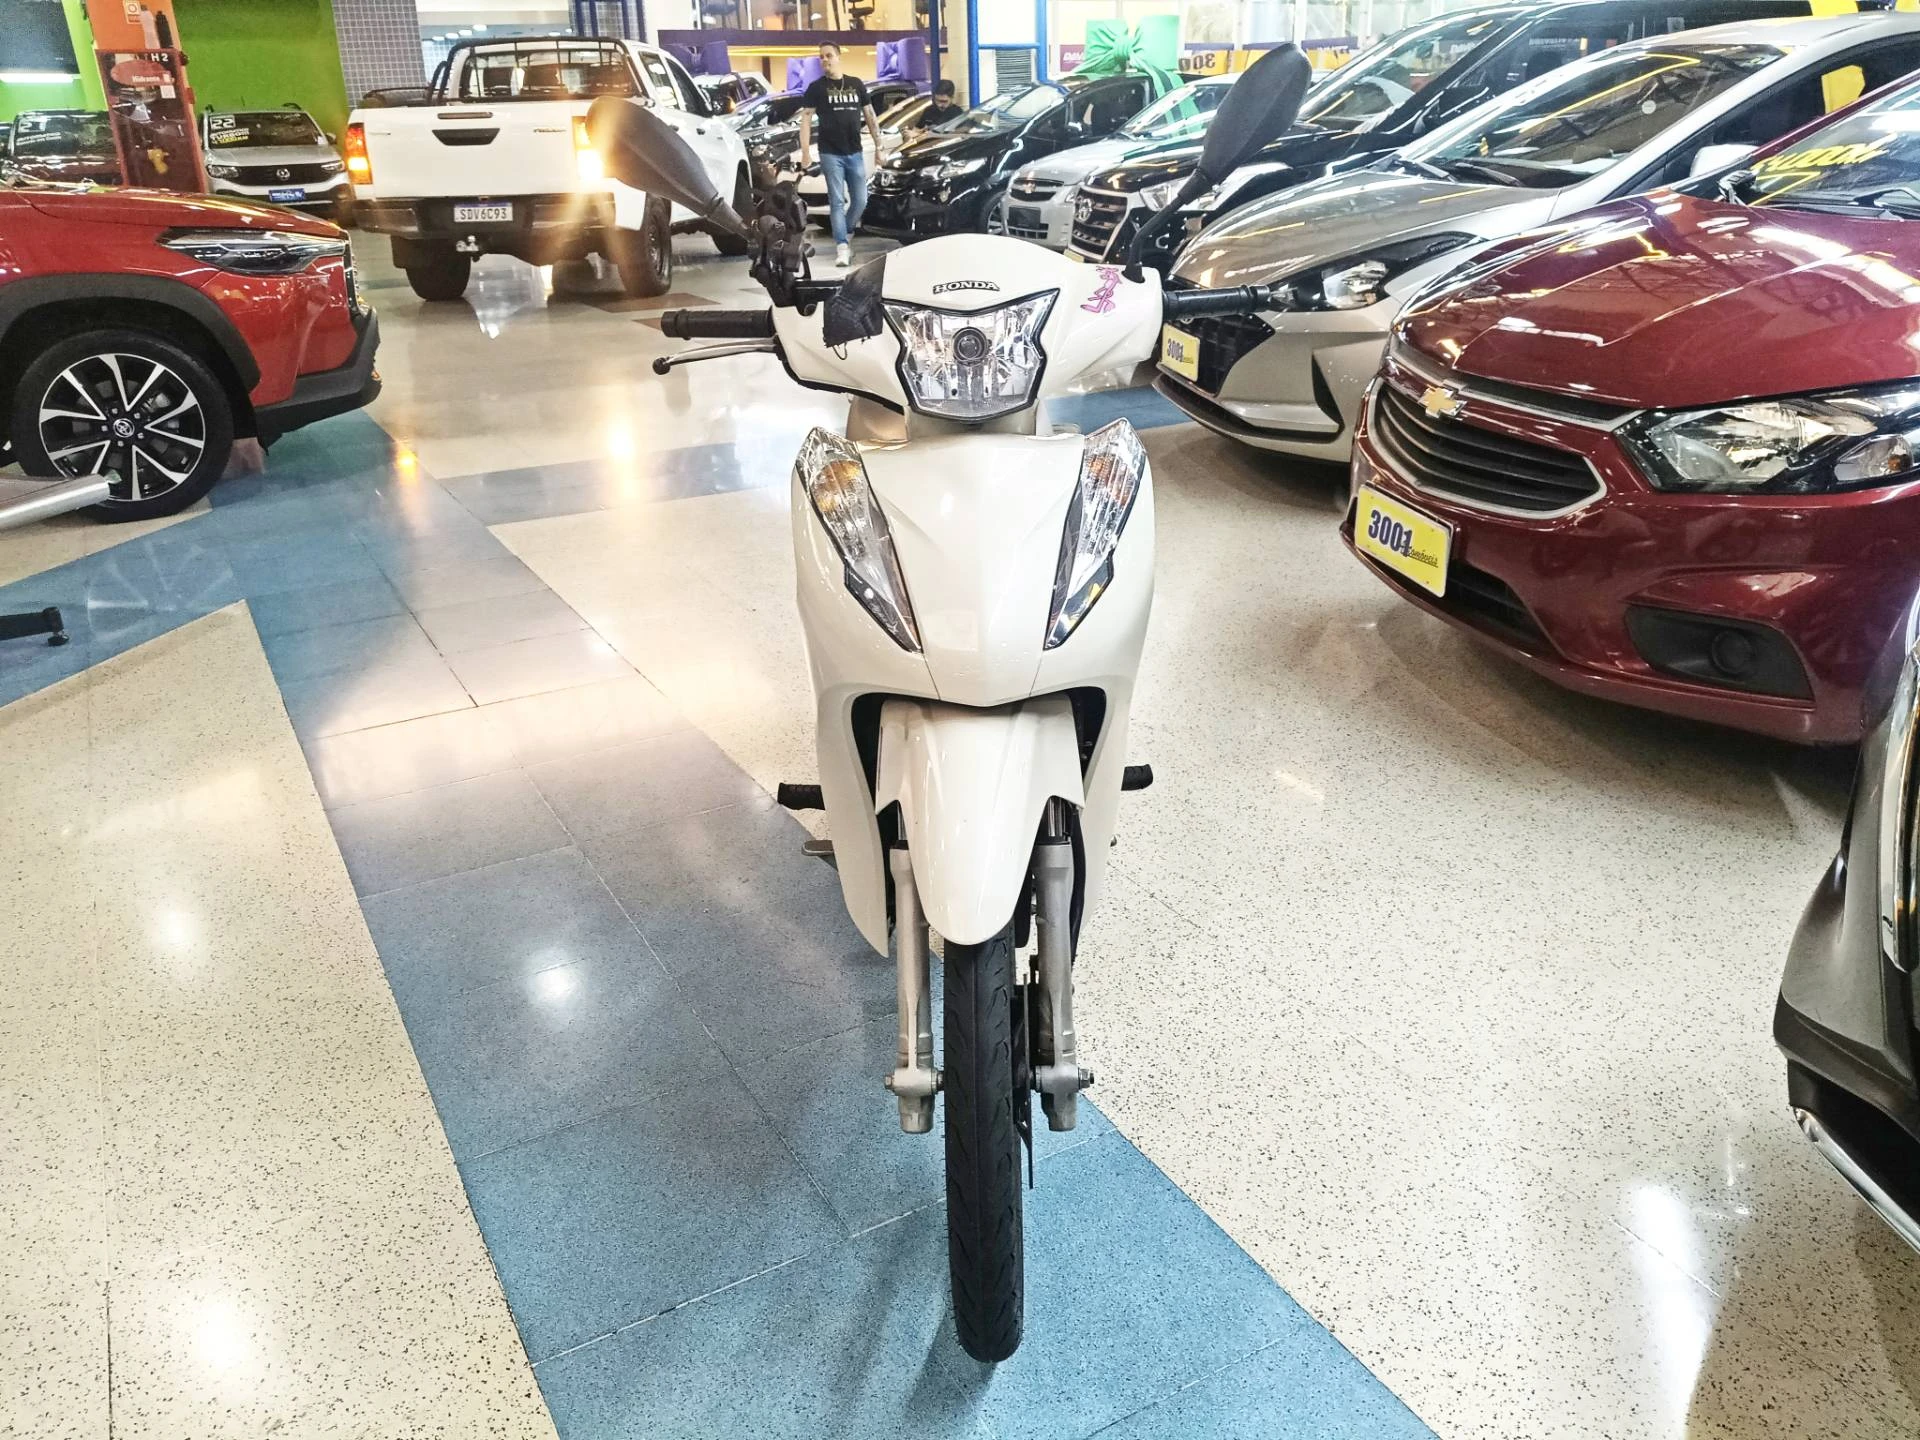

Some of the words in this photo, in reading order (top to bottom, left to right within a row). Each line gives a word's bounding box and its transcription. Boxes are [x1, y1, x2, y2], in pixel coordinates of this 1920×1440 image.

[460, 207, 507, 220] SDV6C93
[933, 280, 1000, 294] HONDA
[1368, 509, 1413, 557] 3001
